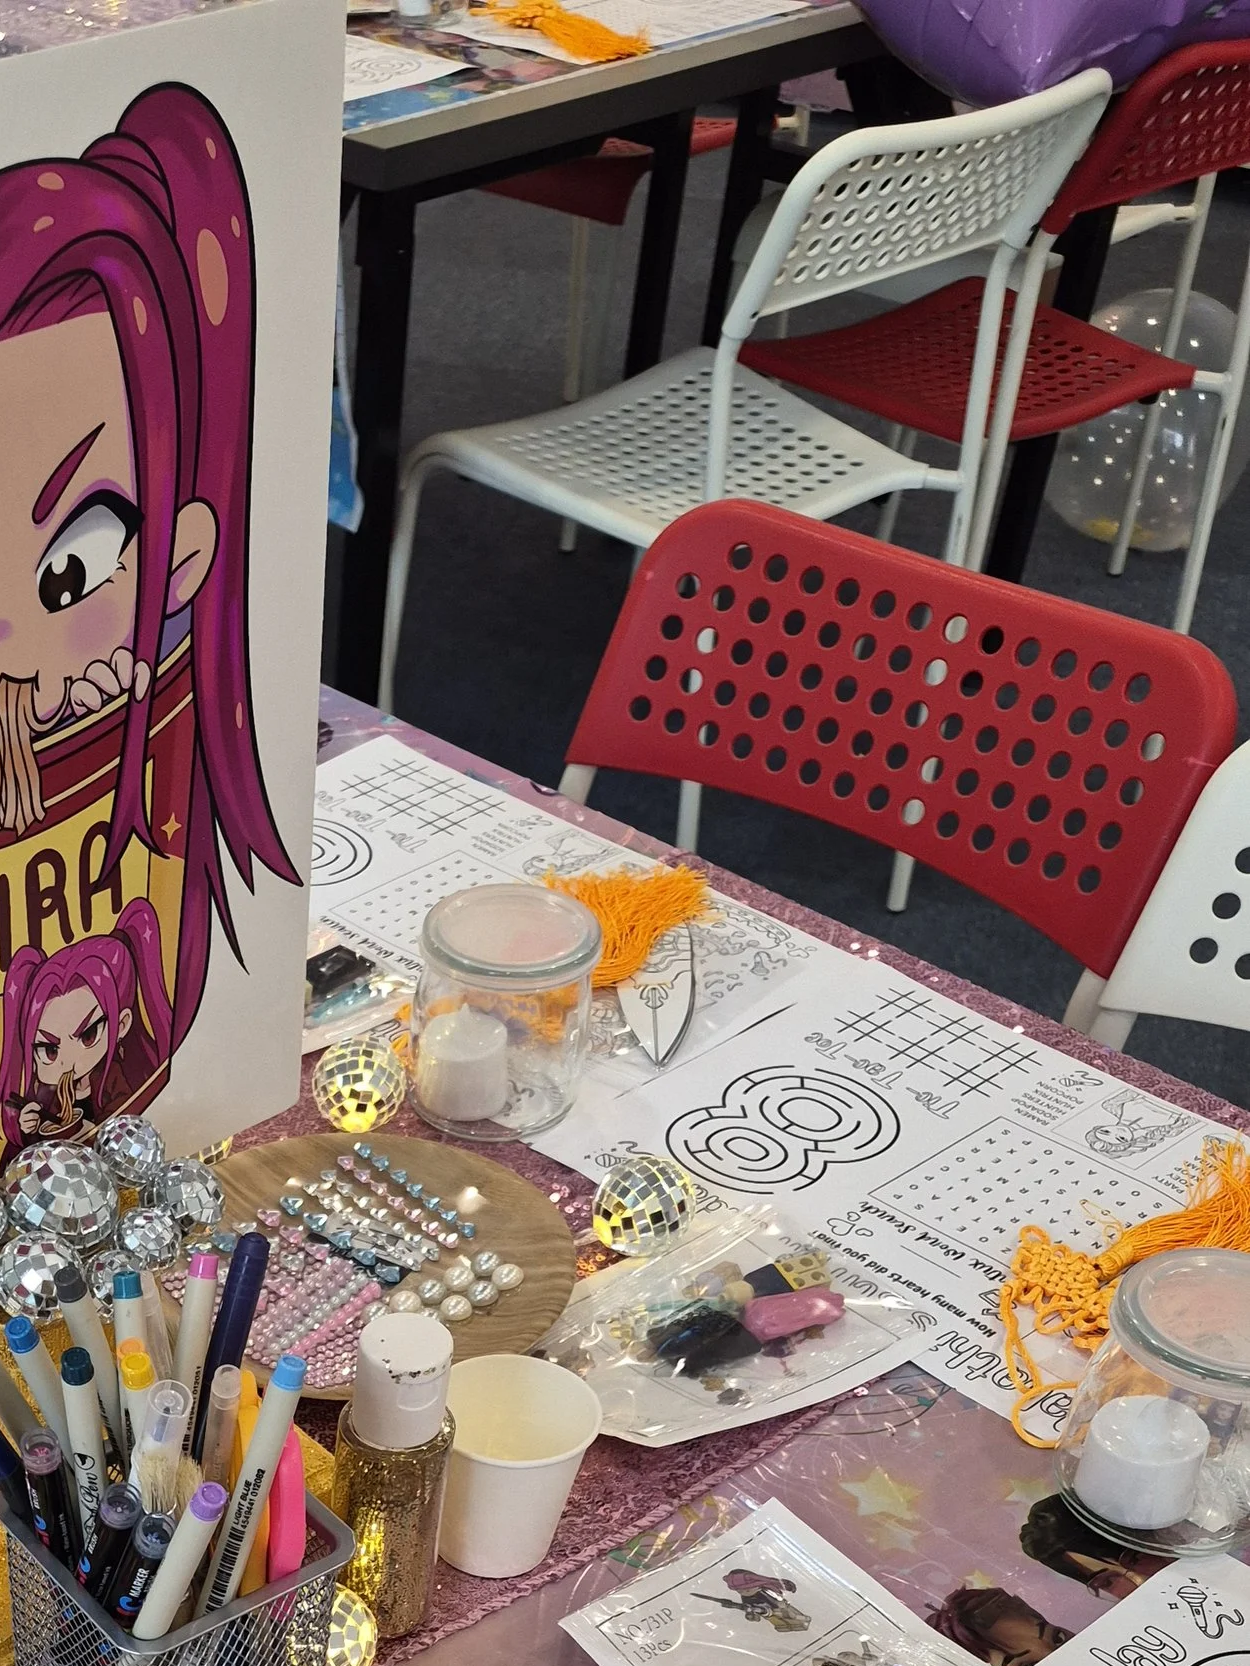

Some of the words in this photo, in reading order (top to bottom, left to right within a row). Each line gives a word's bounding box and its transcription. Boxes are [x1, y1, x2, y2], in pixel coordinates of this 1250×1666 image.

[1022, 1092, 1067, 1116] HUNTERS
[1032, 1088, 1076, 1111] HUNTRIX
[1036, 1081, 1085, 1107] POPCORN
[1011, 1098, 1059, 1121] SODAPOP
[1014, 1107, 1050, 1127] RAMEN
[1151, 1175, 1185, 1194] PARTY
[859, 1201, 916, 1235] Search
[914, 1231, 966, 1261] Word
[864, 1255, 889, 1275] did
[887, 1271, 931, 1298] hearts
[931, 1294, 967, 1320] many
[967, 1317, 997, 1338] How
[233, 1500, 246, 1526] LIGHT
[240, 1479, 253, 1502] BLUE
[129, 1568, 150, 1597] MARKER
